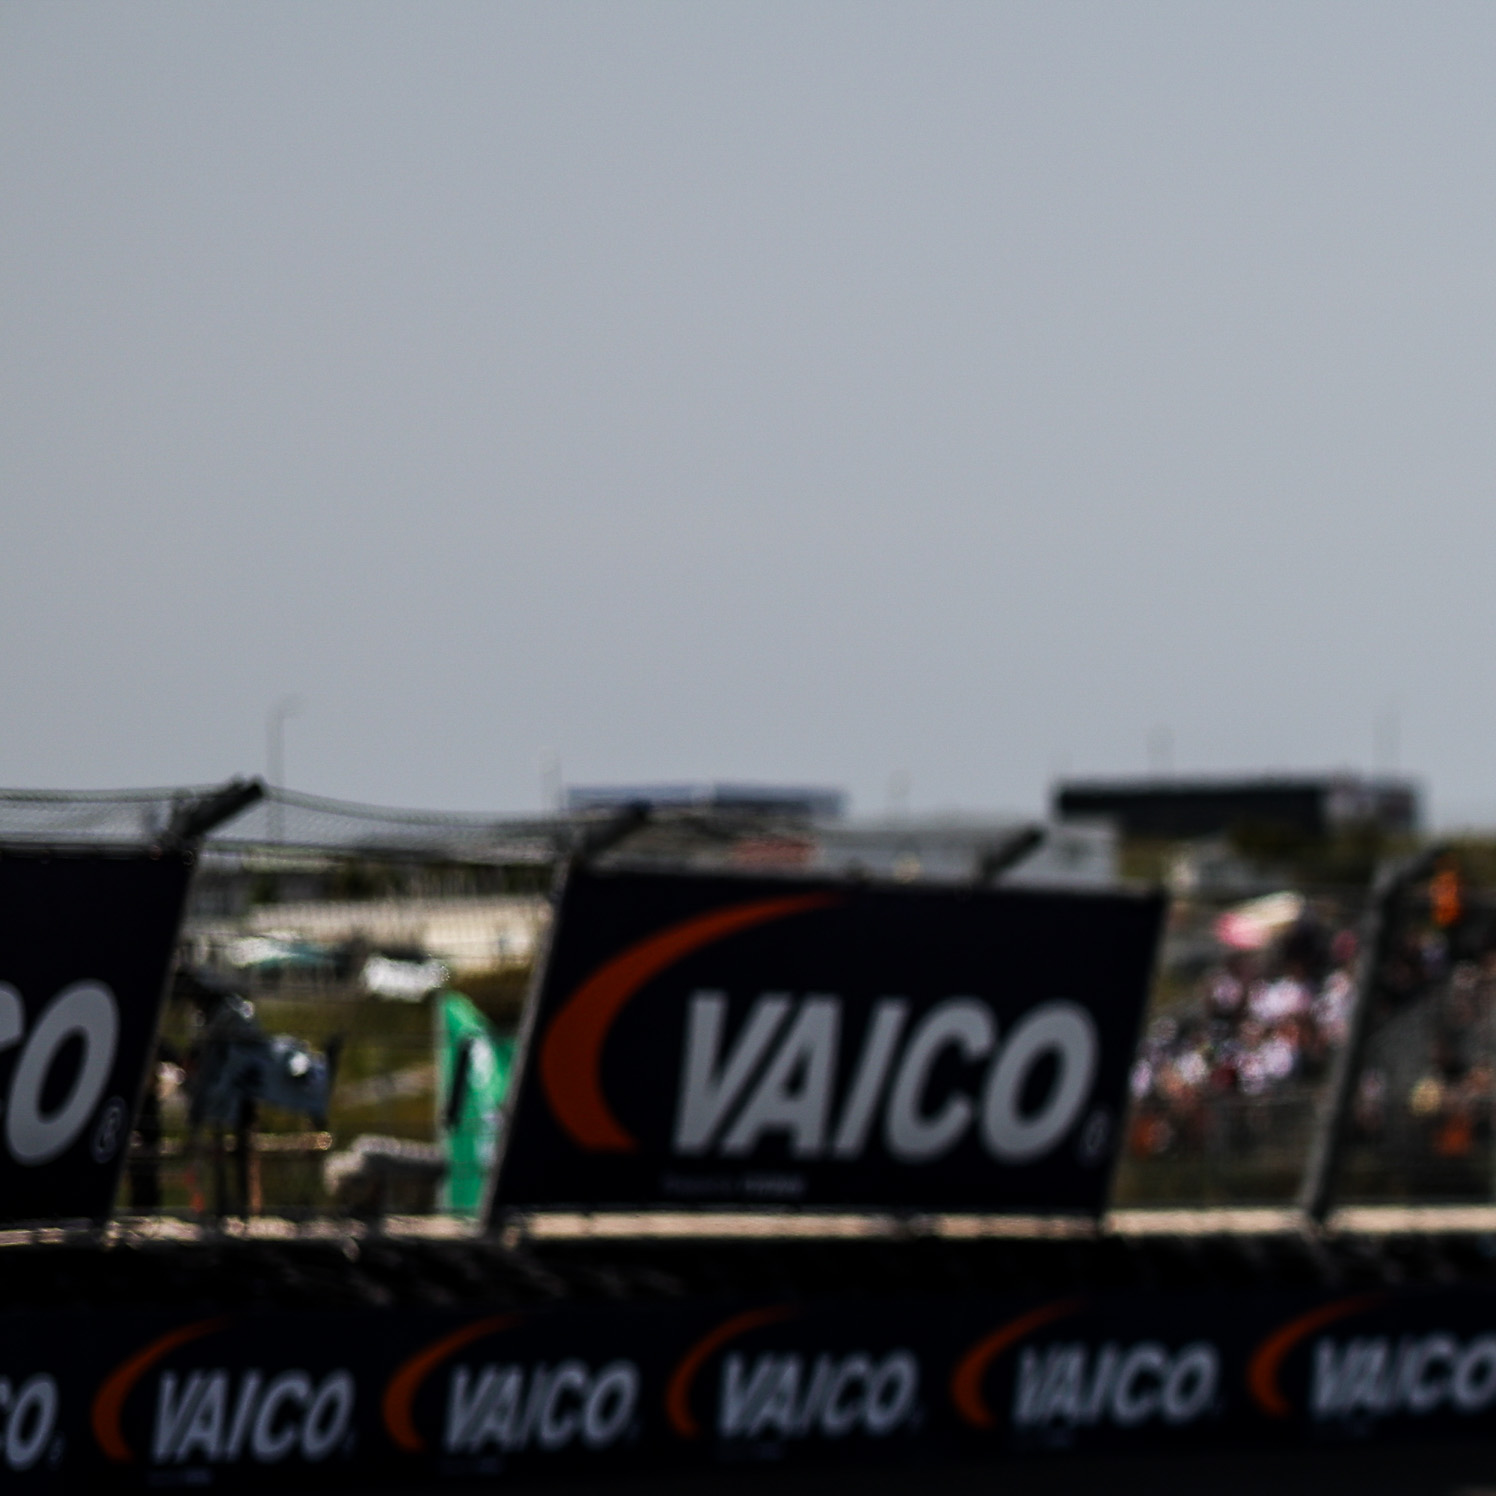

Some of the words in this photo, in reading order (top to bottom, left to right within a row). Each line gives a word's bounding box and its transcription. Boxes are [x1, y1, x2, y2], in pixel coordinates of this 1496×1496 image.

[672, 989, 1098, 1162] VAICO
[151, 1369, 354, 1463] VAICO
[445, 1361, 641, 1452] VAICO
[718, 1351, 918, 1438] VAICO
[1014, 1342, 1220, 1428] VAICO
